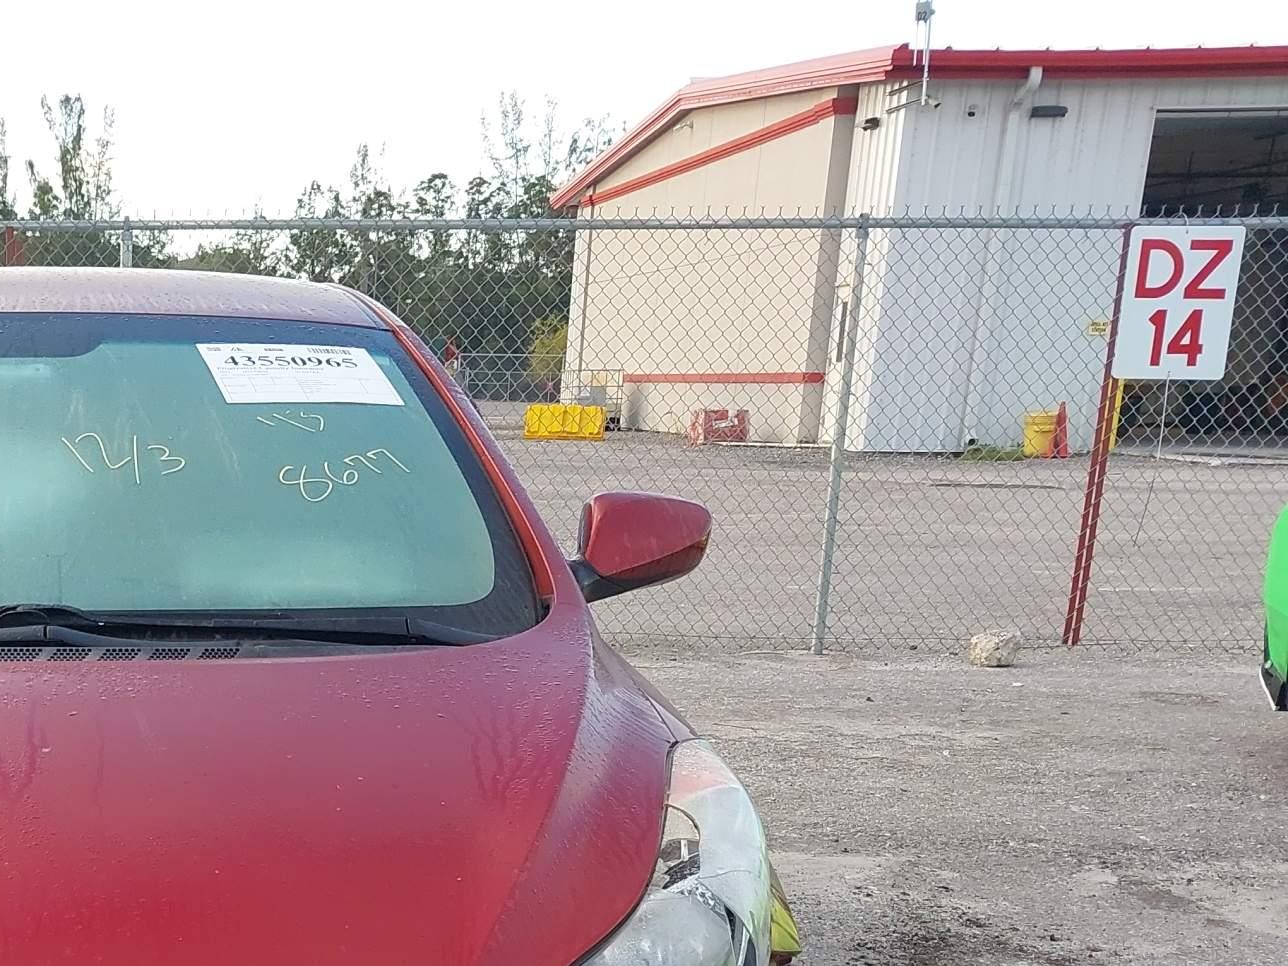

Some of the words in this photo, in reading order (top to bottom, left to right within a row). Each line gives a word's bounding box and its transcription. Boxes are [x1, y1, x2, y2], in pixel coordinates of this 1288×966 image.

[1134, 239, 1234, 299] DZ
[224, 354, 358, 369] 43550965
[1148, 309, 1204, 366] 14
